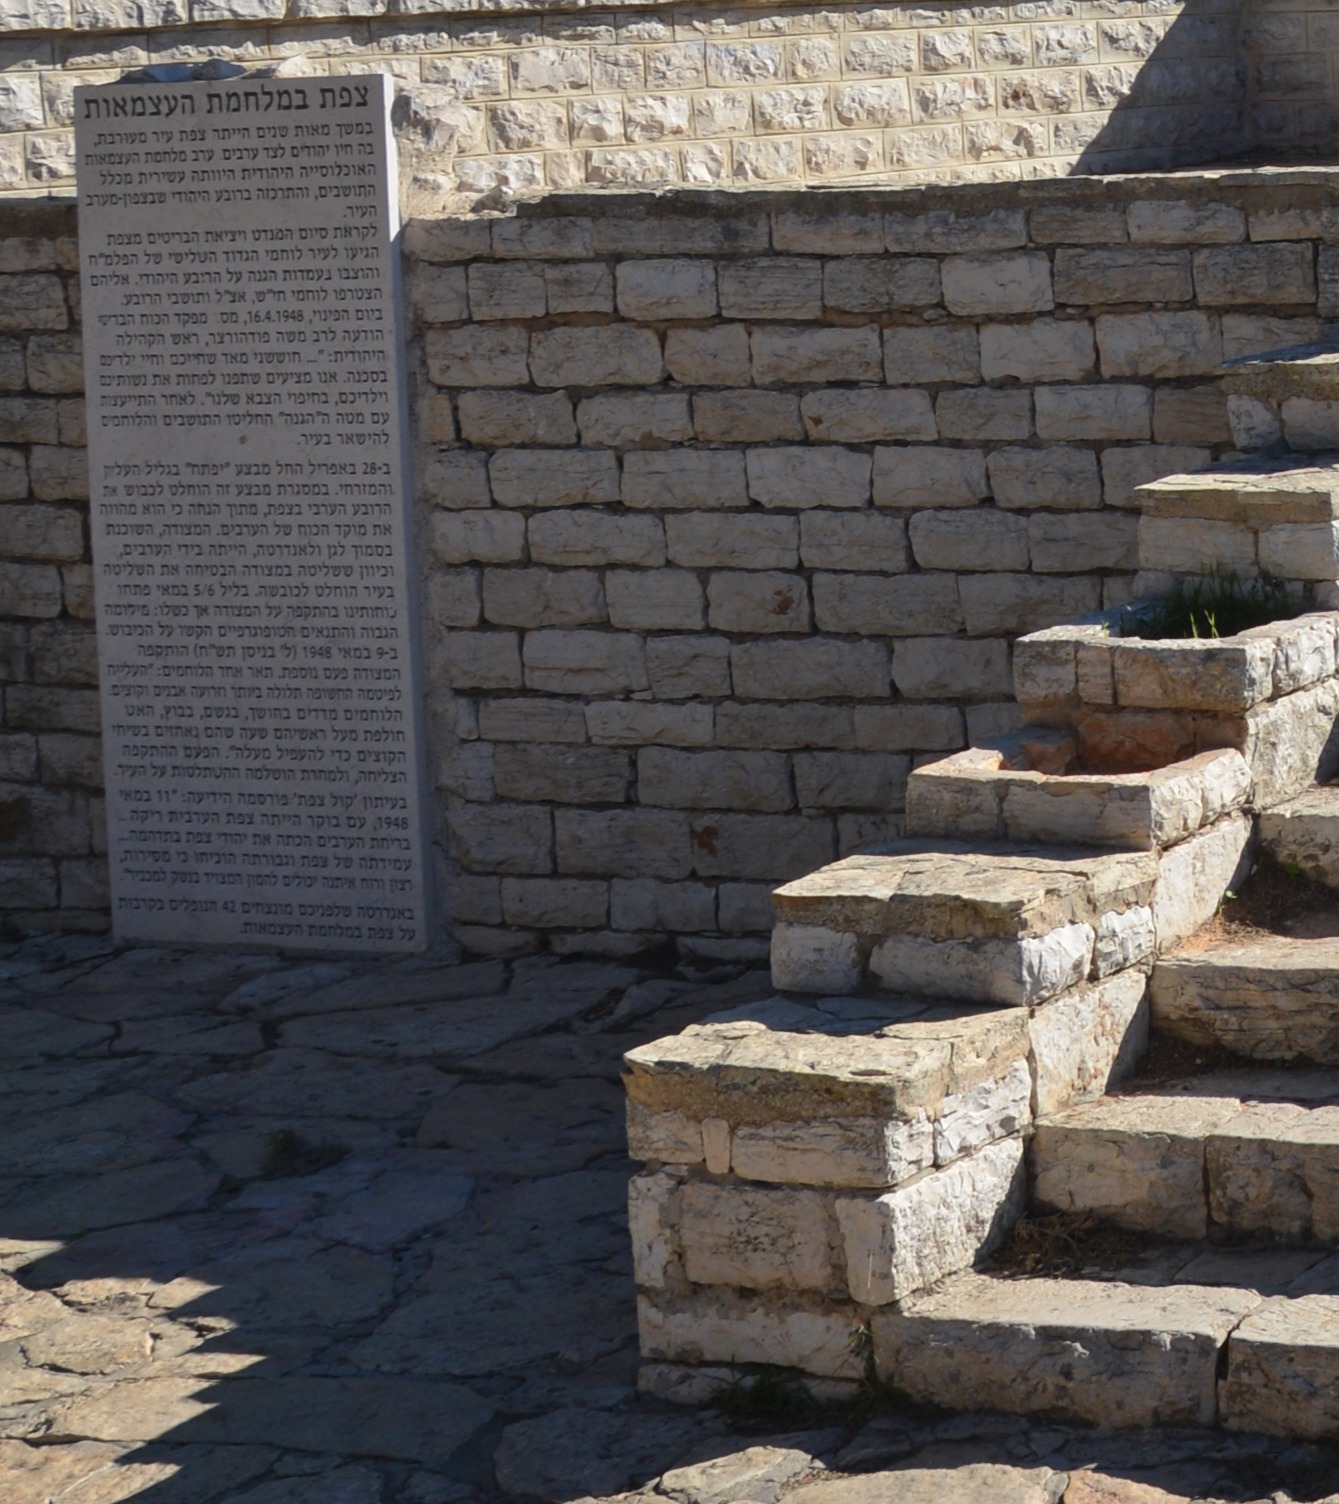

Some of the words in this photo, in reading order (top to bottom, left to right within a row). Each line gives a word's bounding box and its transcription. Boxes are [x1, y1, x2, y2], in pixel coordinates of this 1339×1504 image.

[205, 84, 310, 114] במלחמת
[318, 84, 369, 109] צפת
[83, 93, 196, 120] העצמאות
[151, 130, 173, 144] עיר
[178, 128, 206, 142] צפת
[255, 125, 289, 139] שנים
[293, 123, 330, 137] מאות
[334, 121, 374, 139] במשך
[191, 148, 214, 162] ערב
[262, 142, 286, 159] לצד
[289, 143, 330, 158] יהודים
[333, 142, 353, 156] חיו
[357, 141, 375, 155] בה
[83, 151, 140, 166] העצמאות
[143, 147, 187, 164] מלחמת
[190, 168, 235, 182] היוותה
[240, 165, 294, 180] היהודית
[298, 160, 376, 178] האוכלוסייה
[98, 169, 133, 185] מכלל
[137, 170, 186, 184] עשירית
[170, 189, 211, 203] היהודי
[213, 188, 252, 203] ברובע
[255, 185, 310, 201] והתרכזה
[145, 230, 200, 245] הבריטים
[203, 229, 247, 243] ויציאת
[250, 227, 293, 242] המנדט
[297, 226, 329, 240] סיום
[332, 221, 378, 241] לקראת
[105, 232, 142, 246] מצפת
[143, 249, 163, 265] של
[221, 249, 259, 262] הגדוד
[264, 245, 303, 261] לוחמי
[307, 243, 338, 261] לעיר
[343, 245, 380, 261] הגיעו
[88, 270, 130, 287] אליהם
[225, 267, 243, 284] על
[246, 269, 277, 282] הגנה
[336, 266, 380, 280] והוצבו
[166, 291, 210, 305] ותושבי
[290, 285, 328, 302] לוחמי
[332, 286, 382, 301] הצטרפו
[138, 312, 170, 325] הכוח
[173, 311, 208, 328] מפקד
[354, 307, 384, 321] ביום
[115, 330, 165, 349] הקהילה
[169, 332, 199, 345] ראש
[275, 330, 307, 343] משה
[311, 325, 337, 343] לרב
[341, 328, 384, 343] הודעה
[139, 353, 164, 365] וחיי
[220, 351, 249, 364] מאד
[252, 350, 301, 364] חוששני
[151, 373, 171, 386] את
[175, 369, 216, 386] לפחות
[220, 372, 261, 385] שתפנו
[265, 371, 312, 385] מציעים
[316, 370, 338, 384] אנו
[160, 390, 196, 406] לאחר
[245, 392, 281, 405] הצבא
[286, 391, 329, 405] בחיפוי
[161, 413, 221, 427] התושבים
[225, 409, 274, 426] החליטו
[335, 411, 365, 425] מטה
[369, 411, 390, 425] עם
[335, 428, 390, 445] להישאר
[144, 459, 181, 476] בגליל
[234, 462, 271, 477] מבצע
[274, 458, 303, 475] החל
[307, 458, 357, 475] באפריל
[123, 480, 164, 497] לכבוש
[167, 480, 211, 496] הוחלט
[215, 483, 231, 495] זה
[234, 483, 271, 497] מבצע
[276, 482, 330, 496] במסגרת
[98, 502, 137, 516] מהווה
[141, 503, 166, 515] הוא
[170, 502, 183, 516] כי
[187, 502, 221, 515] הנחה
[225, 502, 258, 518] מתוך
[307, 502, 347, 516] הערבי
[350, 502, 392, 516] הרובע
[104, 522, 154, 536] השוכנת
[272, 520, 292, 536] של
[296, 523, 330, 536] הכוח
[333, 523, 367, 539] מוקד
[371, 523, 392, 536] את
[176, 543, 204, 556] בידי
[207, 543, 247, 556] הייתה
[326, 540, 346, 559] לגן
[350, 543, 393, 559] בסמוך
[102, 560, 155, 576] השליטה
[159, 563, 179, 576] את
[184, 563, 236, 577] הבטיחה
[241, 563, 293, 577] במצודה
[297, 561, 354, 578] ששליטה
[358, 564, 395, 580] וכיוון
[155, 583, 189, 597] במאי
[193, 583, 215, 597] 5/6
[218, 580, 250, 597] בליל
[313, 581, 358, 598] הוחלט
[362, 585, 395, 599] בעיר
